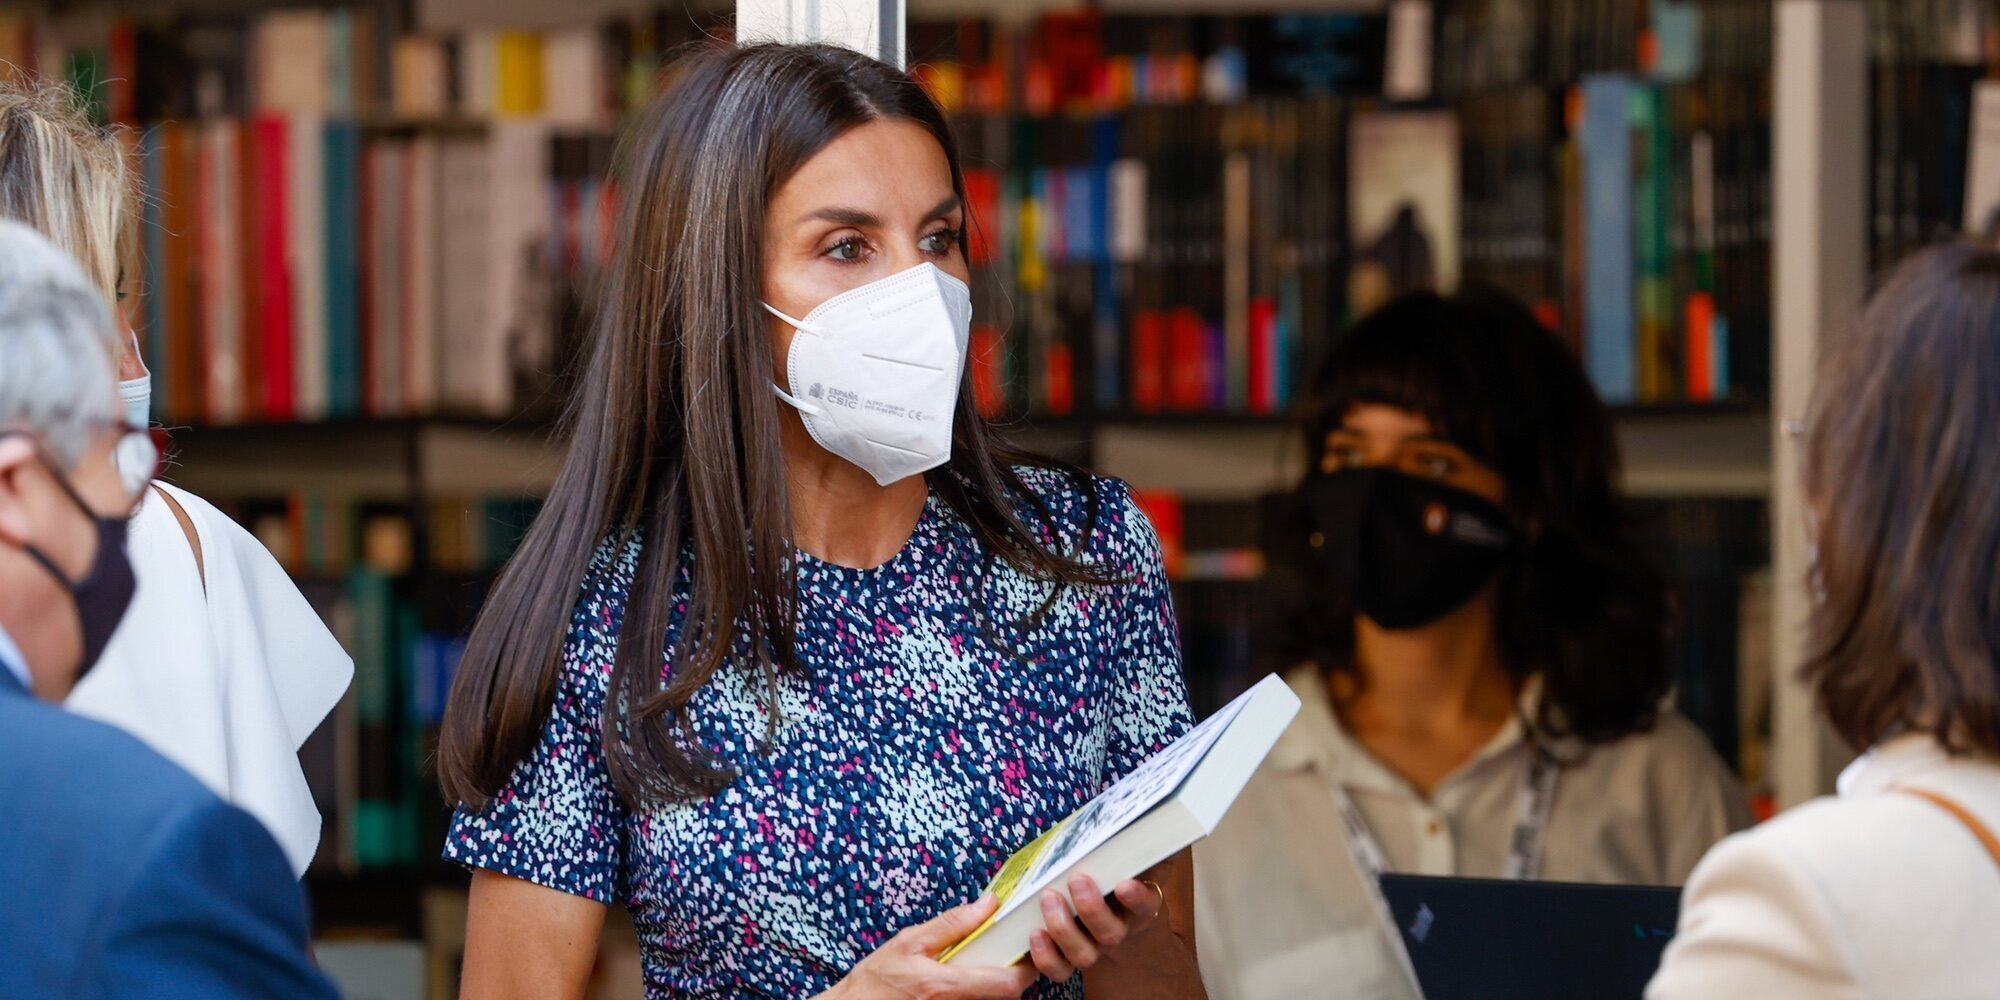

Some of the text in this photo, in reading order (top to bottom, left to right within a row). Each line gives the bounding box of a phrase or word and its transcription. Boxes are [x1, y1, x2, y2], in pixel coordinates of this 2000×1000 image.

[828, 387, 858, 401] ESPAÑA
[827, 395, 857, 409] CSIC
[908, 409, 922, 421] CE
